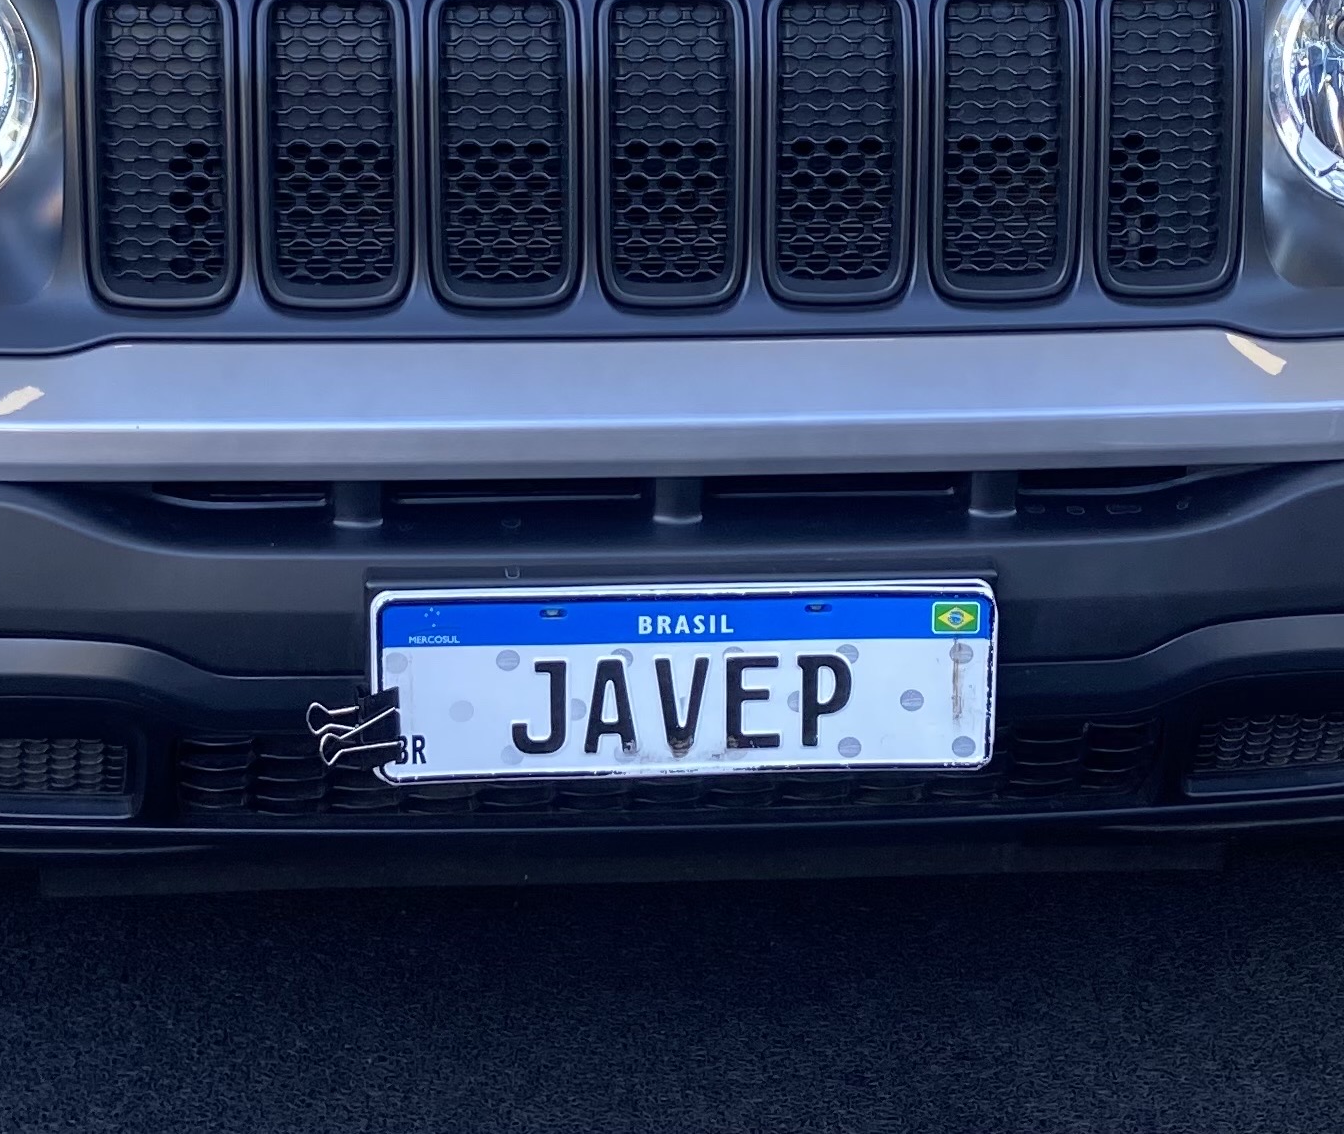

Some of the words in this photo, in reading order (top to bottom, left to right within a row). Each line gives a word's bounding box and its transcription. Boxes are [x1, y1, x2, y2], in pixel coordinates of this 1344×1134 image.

[637, 614, 735, 636] BRASIL
[408, 634, 461, 645] MERCOSUL
[511, 652, 853, 757] JAVEP
